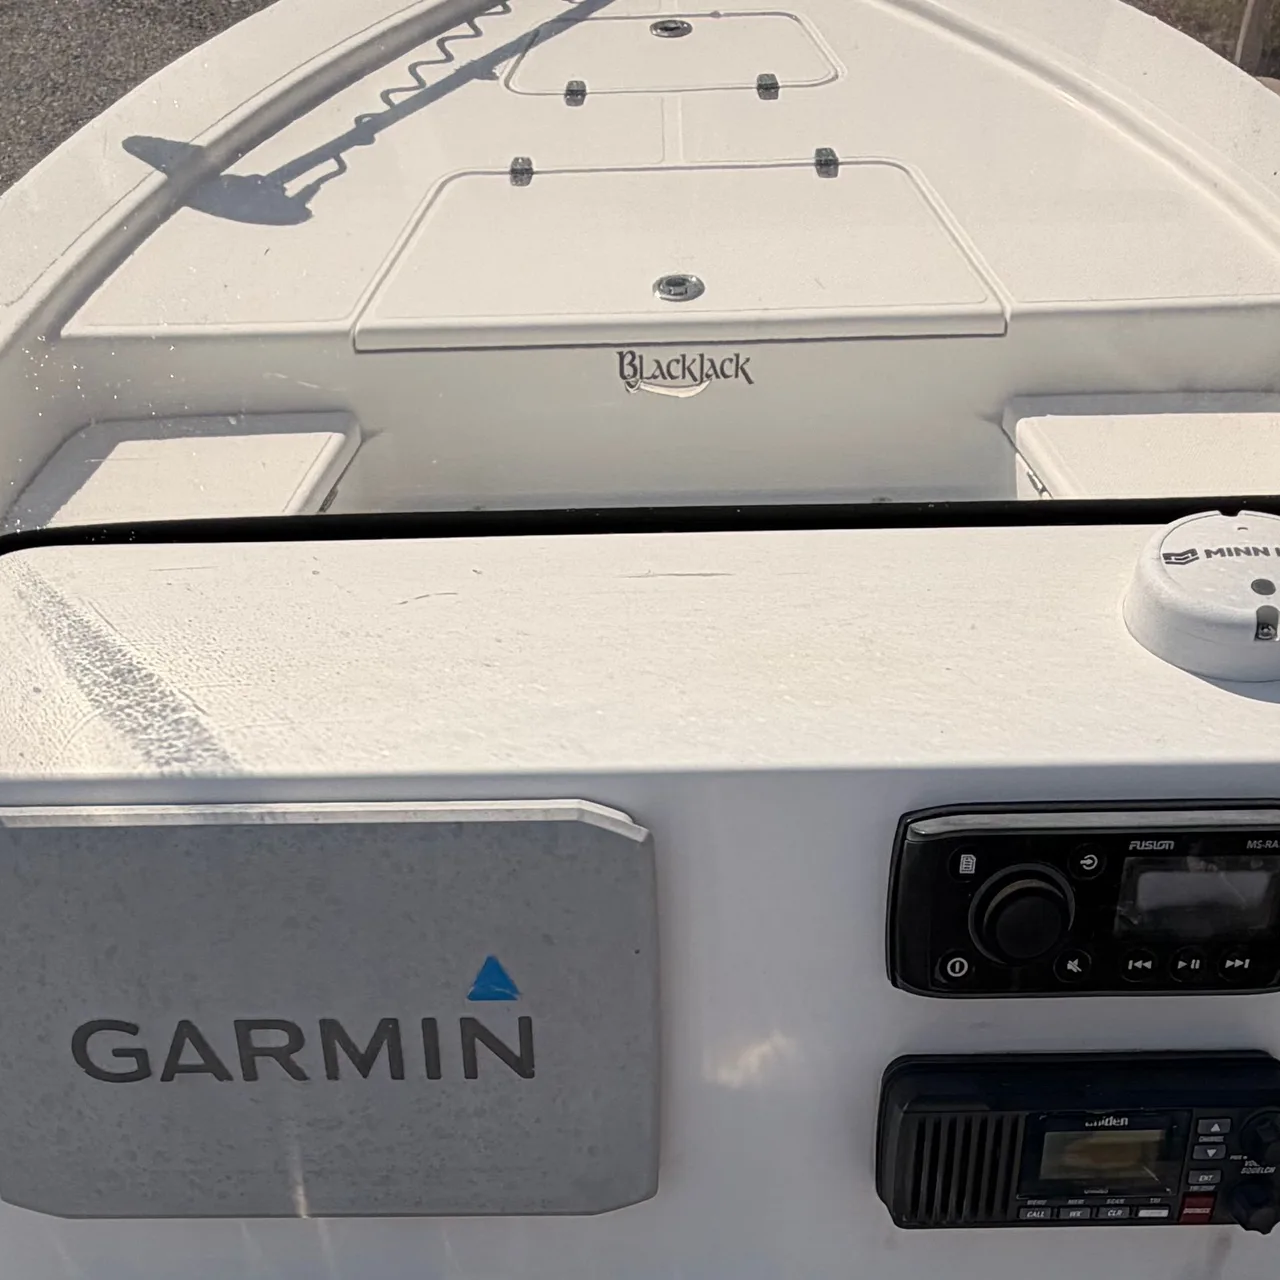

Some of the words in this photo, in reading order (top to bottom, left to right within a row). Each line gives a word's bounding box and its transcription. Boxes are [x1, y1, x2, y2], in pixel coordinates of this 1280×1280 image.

[1205, 546, 1270, 559] MINN
[1129, 841, 1175, 850] FUSION
[71, 1015, 535, 1084] GARMIN
